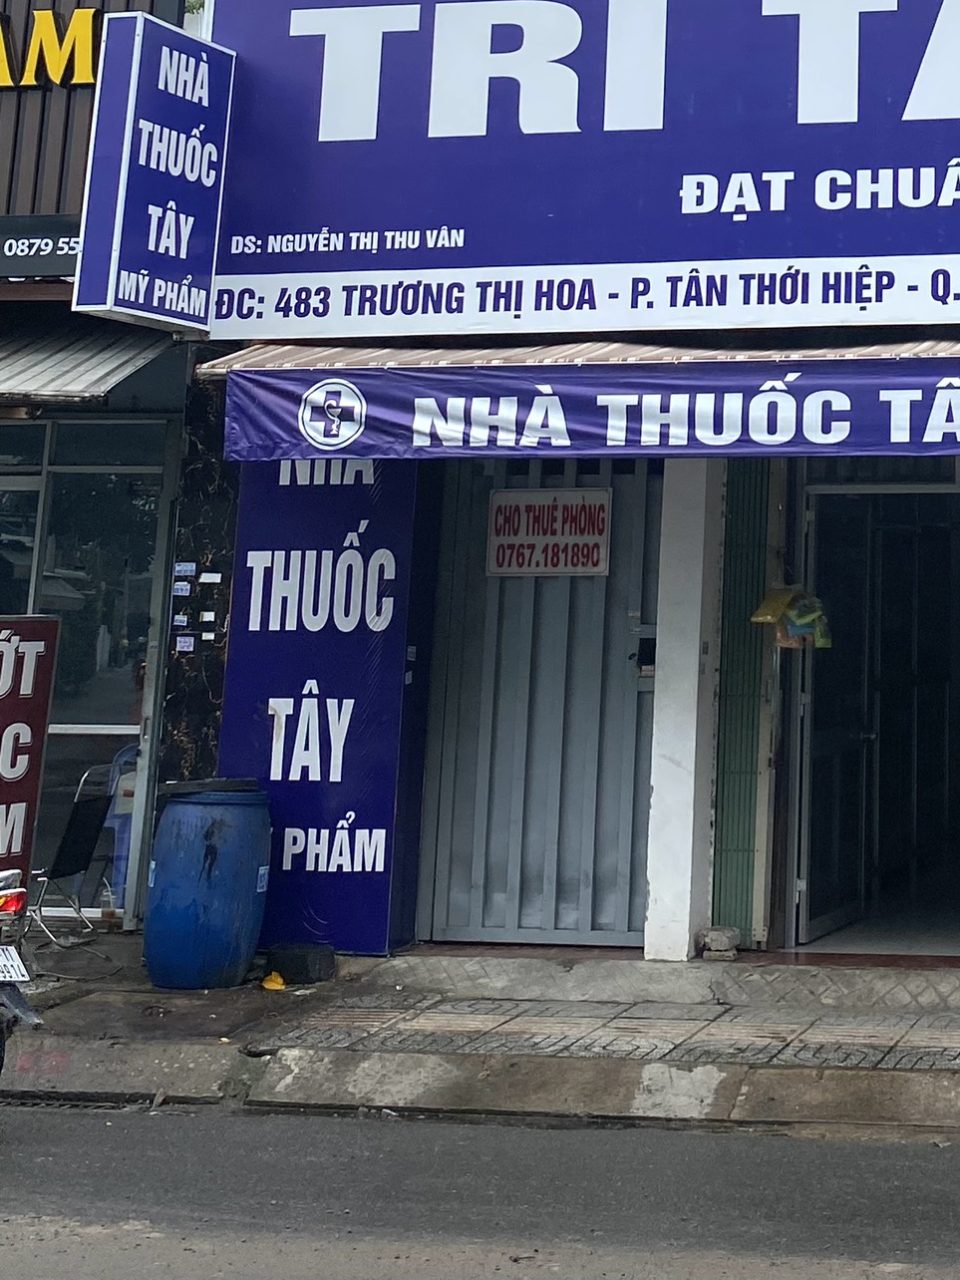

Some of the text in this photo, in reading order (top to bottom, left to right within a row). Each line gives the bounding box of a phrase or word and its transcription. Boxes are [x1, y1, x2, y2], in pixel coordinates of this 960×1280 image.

[0, 8, 96, 86] M
[158, 46, 209, 107] NHÀ
[139, 119, 217, 187] THUỐC
[680, 172, 794, 221] ĐẠT
[4, 239, 53, 256] 0879
[148, 201, 194, 259] TÂY
[231, 226, 464, 253] DS: NGUYỄN THỊ THU VÂN
[117, 269, 207, 318] MỸ PHẨM
[215, 288, 264, 319] ĐC:
[275, 287, 330, 318] 483
[342, 280, 464, 316] TRƯƠNG
[476, 280, 523, 319] THỊ
[535, 279, 596, 311] HOA
[631, 278, 653, 308] P.
[666, 268, 727, 307] TÂN
[739, 266, 809, 305] THỚI
[822, 264, 895, 311] HIỆP
[412, 385, 571, 447] NHÀ
[597, 373, 850, 444] THUỐC
[495, 496, 605, 537] CHO THUÊ PHÒNG
[247, 520, 395, 632] THUỐC
[496, 542, 600, 568] 0767.181890
[268, 680, 354, 782] TÂY
[283, 811, 386, 872] PHẨM
